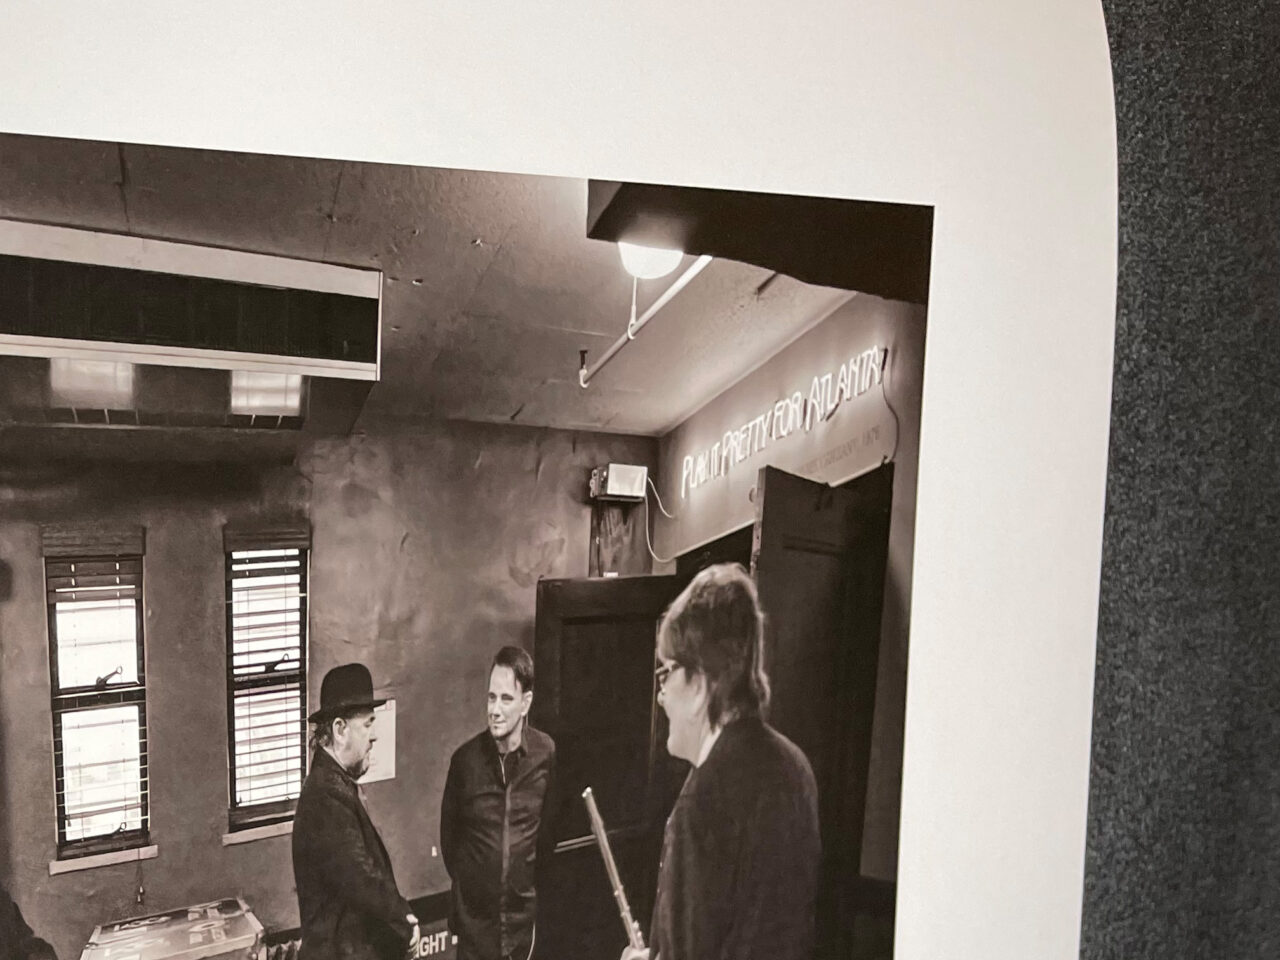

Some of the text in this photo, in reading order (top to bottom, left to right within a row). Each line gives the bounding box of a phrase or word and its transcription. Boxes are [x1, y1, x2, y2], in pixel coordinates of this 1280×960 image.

[681, 450, 709, 499] PLAY
[710, 441, 721, 479] IT
[721, 409, 772, 477] PRETTY
[772, 391, 802, 441] FOR
[805, 344, 881, 432] ATLANTA
[414, 930, 449, 959] IGHT
